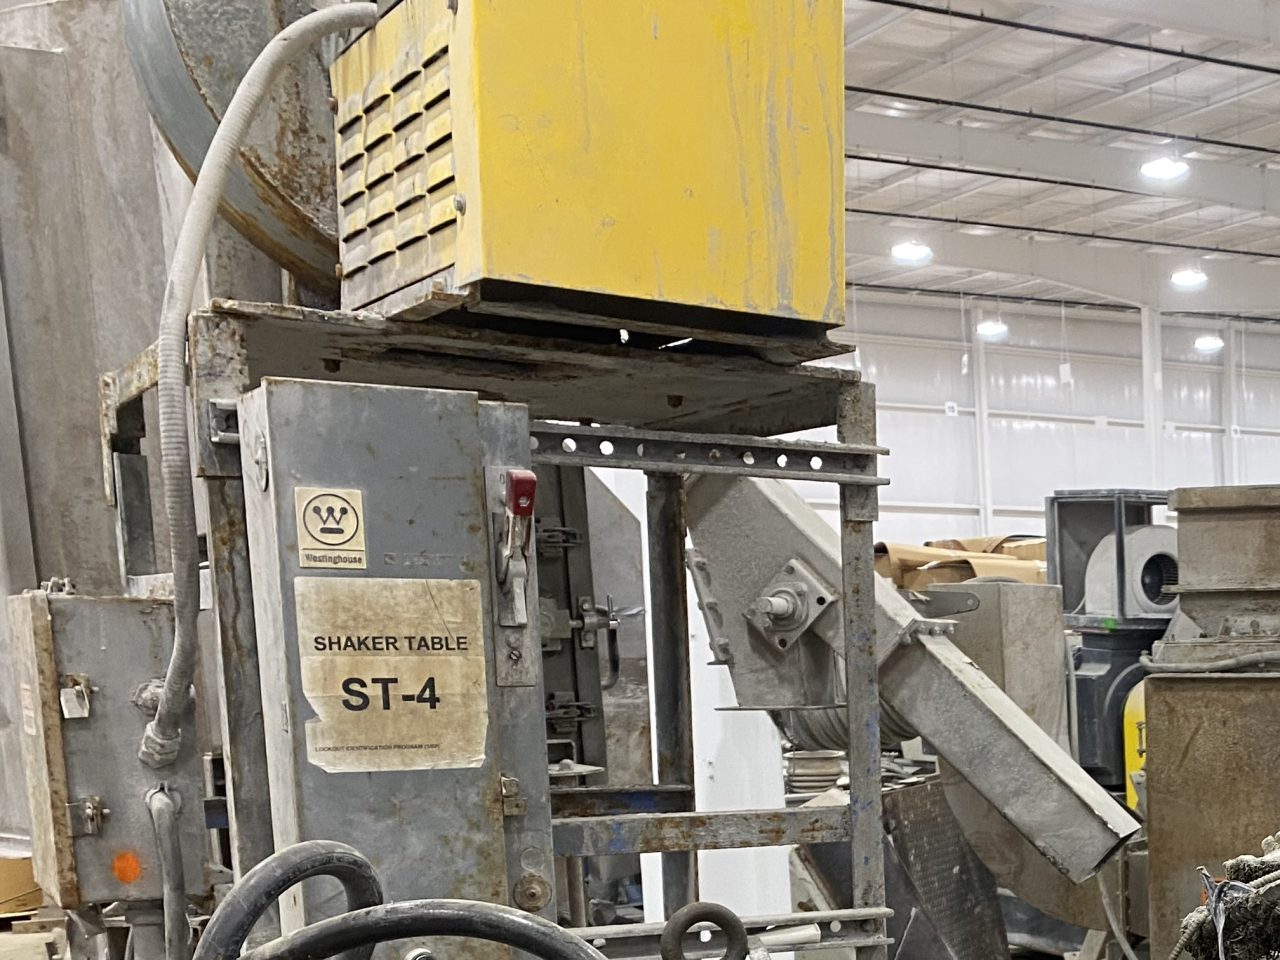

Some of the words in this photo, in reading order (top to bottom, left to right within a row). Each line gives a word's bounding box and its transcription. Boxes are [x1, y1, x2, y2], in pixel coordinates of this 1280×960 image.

[305, 554, 362, 564] Westinghouse
[314, 636, 399, 651] SHAKER
[404, 636, 468, 650] TABLE
[342, 677, 440, 711] ST-4
